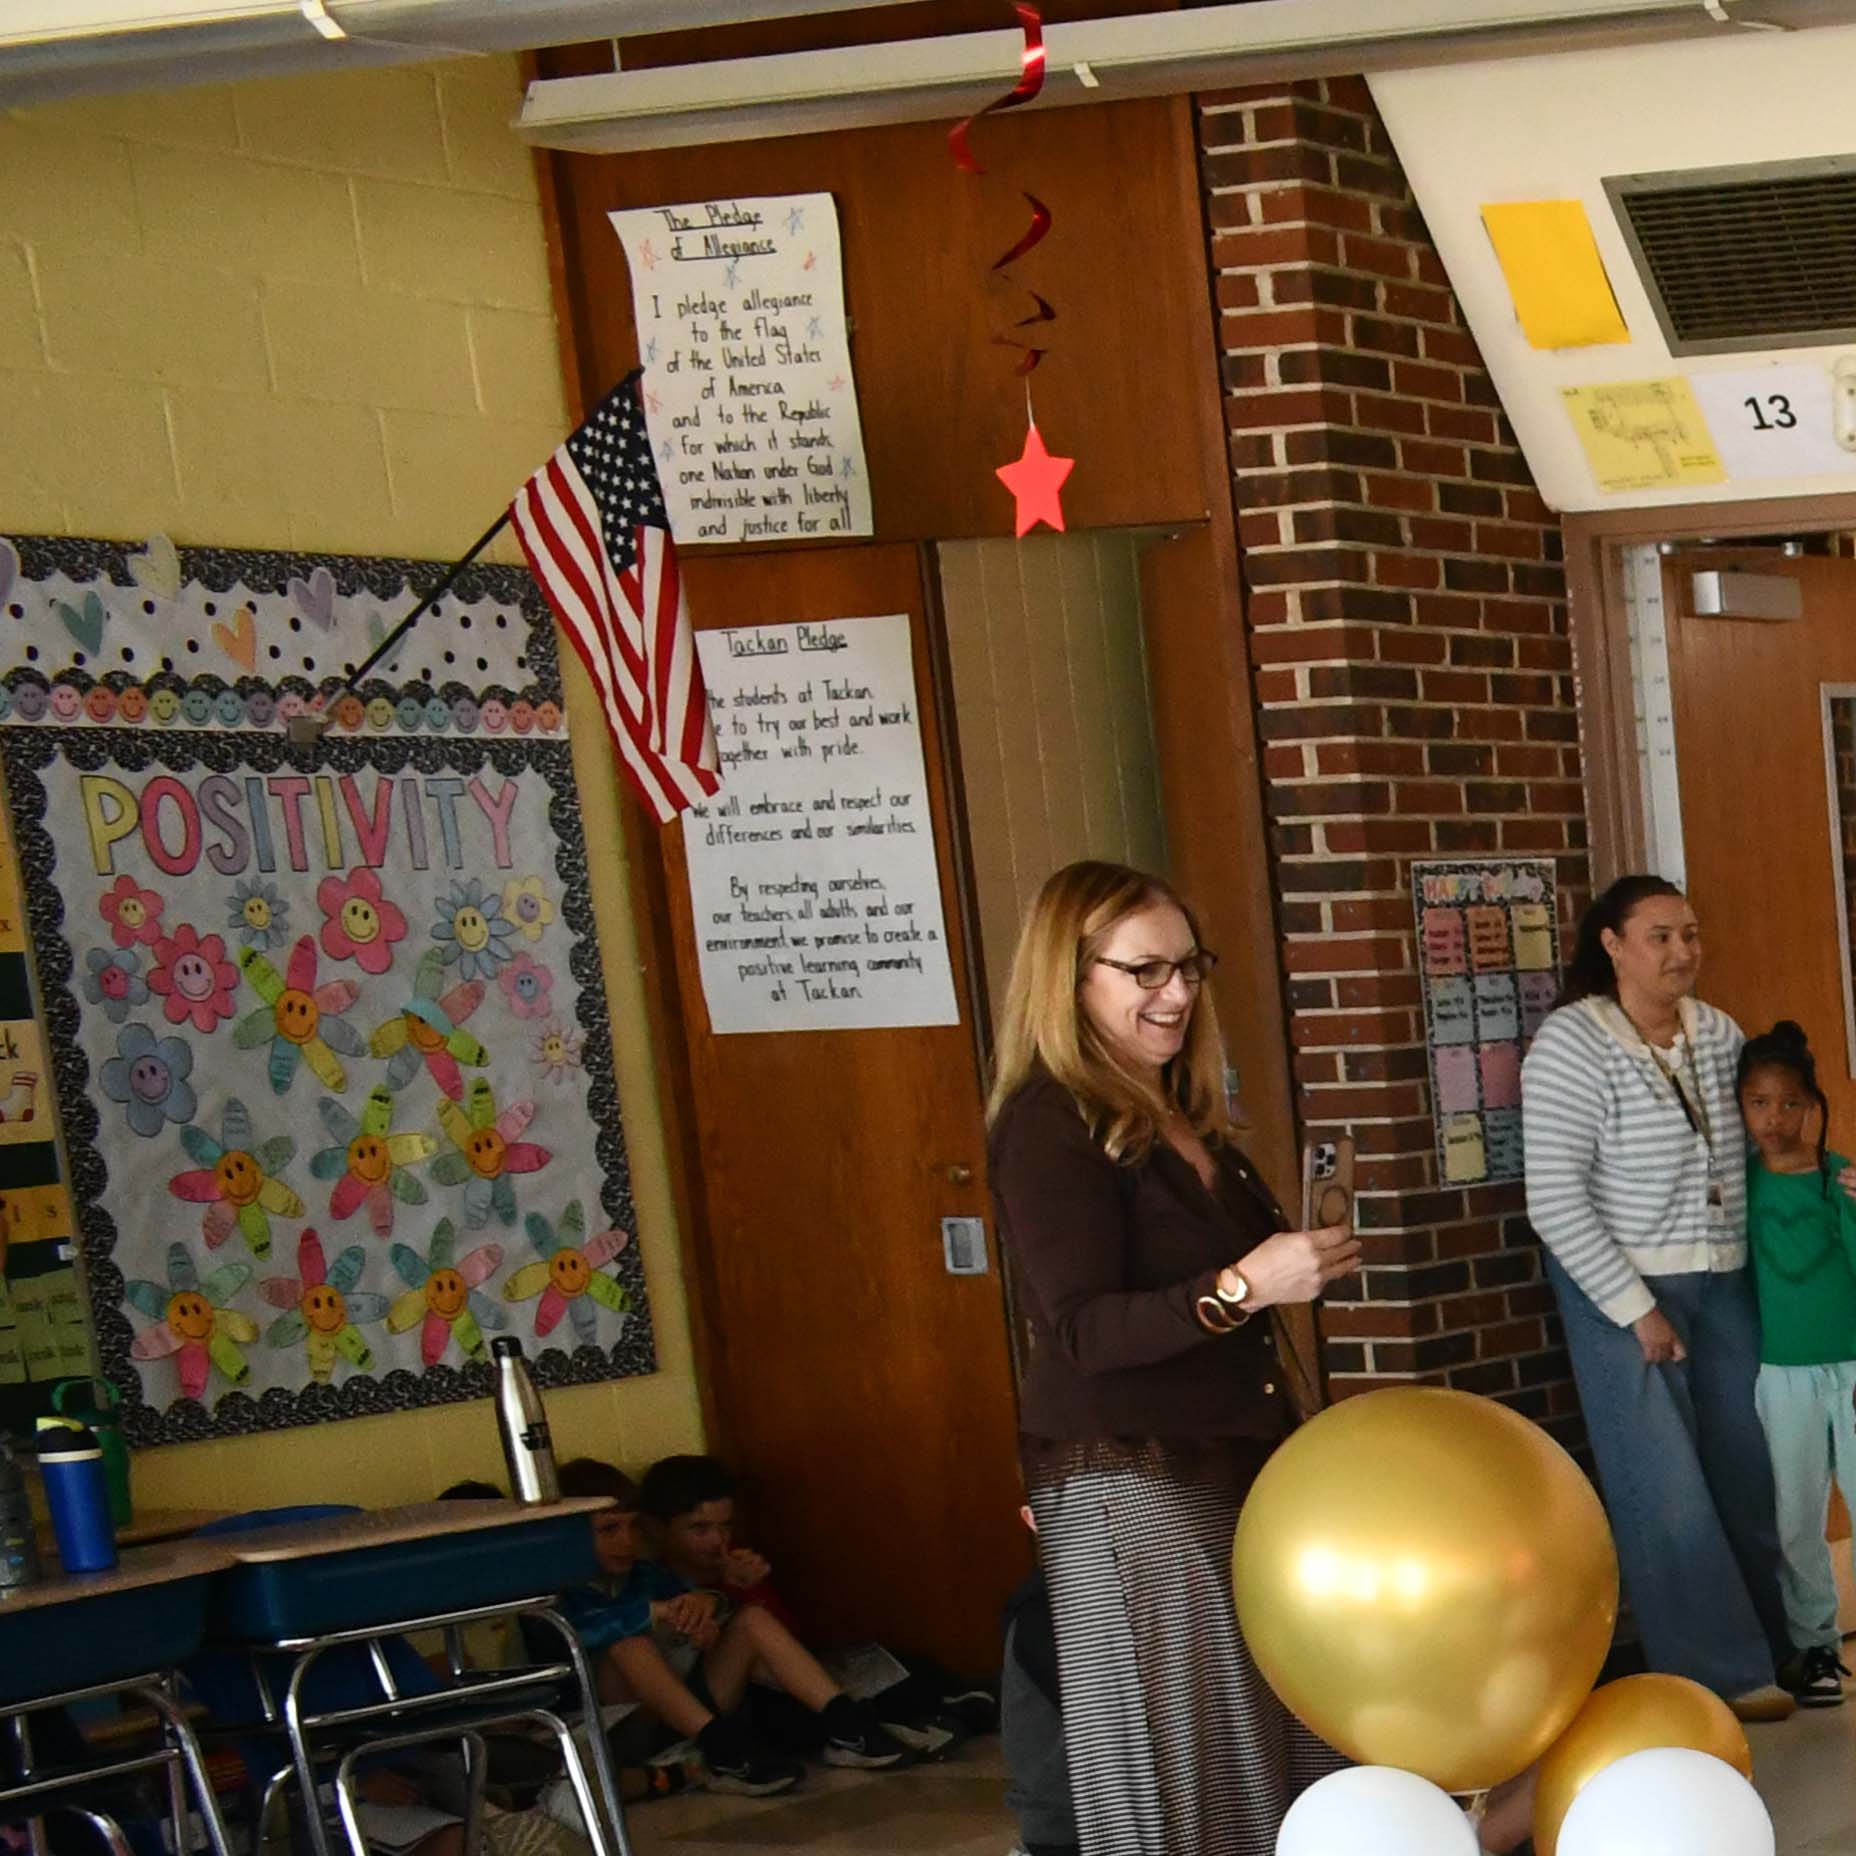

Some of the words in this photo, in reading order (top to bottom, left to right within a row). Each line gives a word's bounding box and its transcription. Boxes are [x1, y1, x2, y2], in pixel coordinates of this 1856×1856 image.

[653, 209, 690, 231] The
[708, 203, 763, 231] Pledge
[703, 235, 777, 262] Allegiance
[651, 295, 662, 319] I
[677, 292, 728, 319] pledge
[742, 289, 813, 316] allegiance
[692, 321, 709, 343] to
[719, 318, 742, 341] the
[753, 316, 788, 347] flag
[666, 351, 681, 374] of
[691, 350, 713, 371] the
[723, 347, 767, 369] United
[776, 341, 823, 366] States
[701, 378, 716, 399] of
[729, 376, 786, 397] America
[1743, 392, 1799, 433] 13
[699, 515, 728, 537] and
[742, 514, 789, 542] justice
[797, 512, 821, 533] for
[829, 510, 852, 531] all
[720, 629, 789, 654] Tackan
[795, 624, 849, 654] Pledge
[733, 683, 788, 707] students
[798, 681, 813, 704] at
[732, 714, 747, 736] to
[757, 713, 781, 739] try
[789, 718, 808, 732] our
[812, 710, 841, 731] best
[849, 705, 874, 727] and
[879, 704, 912, 725] work
[79, 772, 521, 877] POSITIVITY
[737, 954, 794, 982] positive
[800, 953, 861, 978] learning
[770, 980, 787, 1002] at
[795, 978, 863, 1002] Tackan
